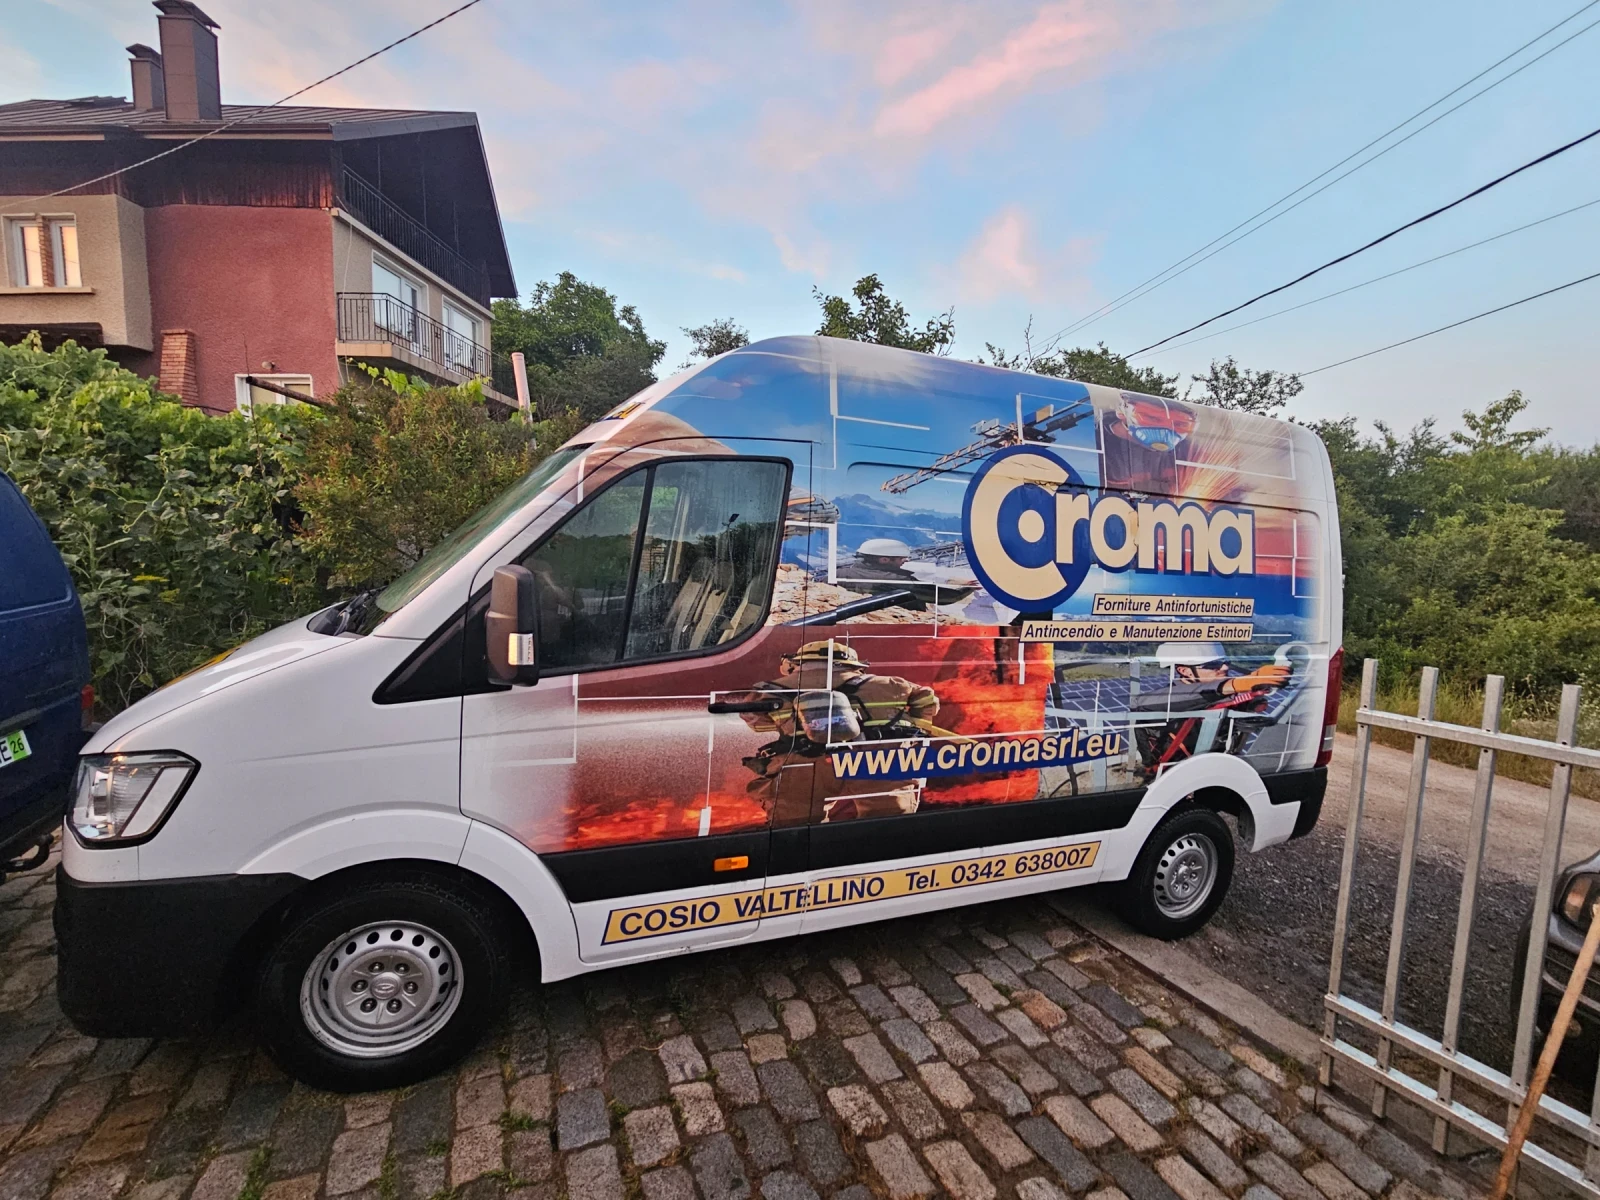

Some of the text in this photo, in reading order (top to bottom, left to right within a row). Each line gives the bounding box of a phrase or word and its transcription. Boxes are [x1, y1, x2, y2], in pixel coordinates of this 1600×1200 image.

[970, 453, 1253, 601] Croma
[1096, 597, 1252, 614] Forniture Antinfortunistiche
[1024, 623, 1251, 639] Antincendio e Manutenzione Estintori
[10, 737, 25, 754] 26
[831, 728, 1122, 778] www.cromasrl.eu
[619, 847, 1091, 936] COSIO VALTELLINO Tel. 0342 638007
